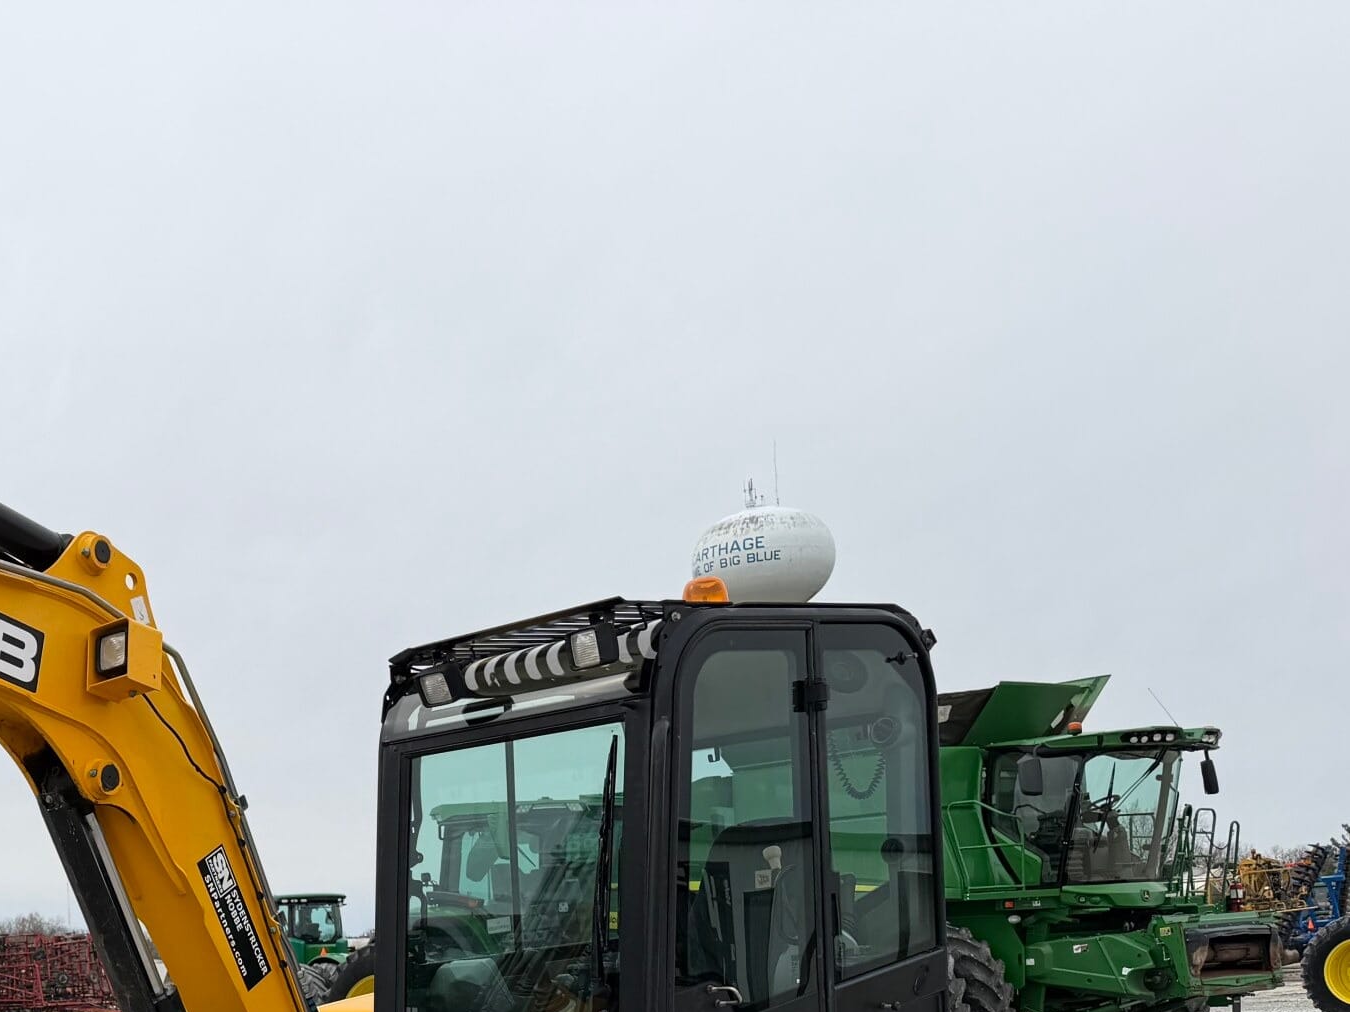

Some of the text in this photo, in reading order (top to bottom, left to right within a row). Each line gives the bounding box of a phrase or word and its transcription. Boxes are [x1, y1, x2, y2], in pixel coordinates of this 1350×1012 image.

[694, 536, 765, 562] ARTHAGE
[703, 561, 714, 573] OF
[719, 555, 741, 568] BIG
[746, 550, 781, 563] BLUE
[208, 858, 224, 895] PARTNERS
[213, 851, 235, 892] SN
[204, 874, 248, 977] SNPartners.com
[224, 894, 244, 933] NOBBE
[230, 889, 268, 977] SYDENSTRICKER
